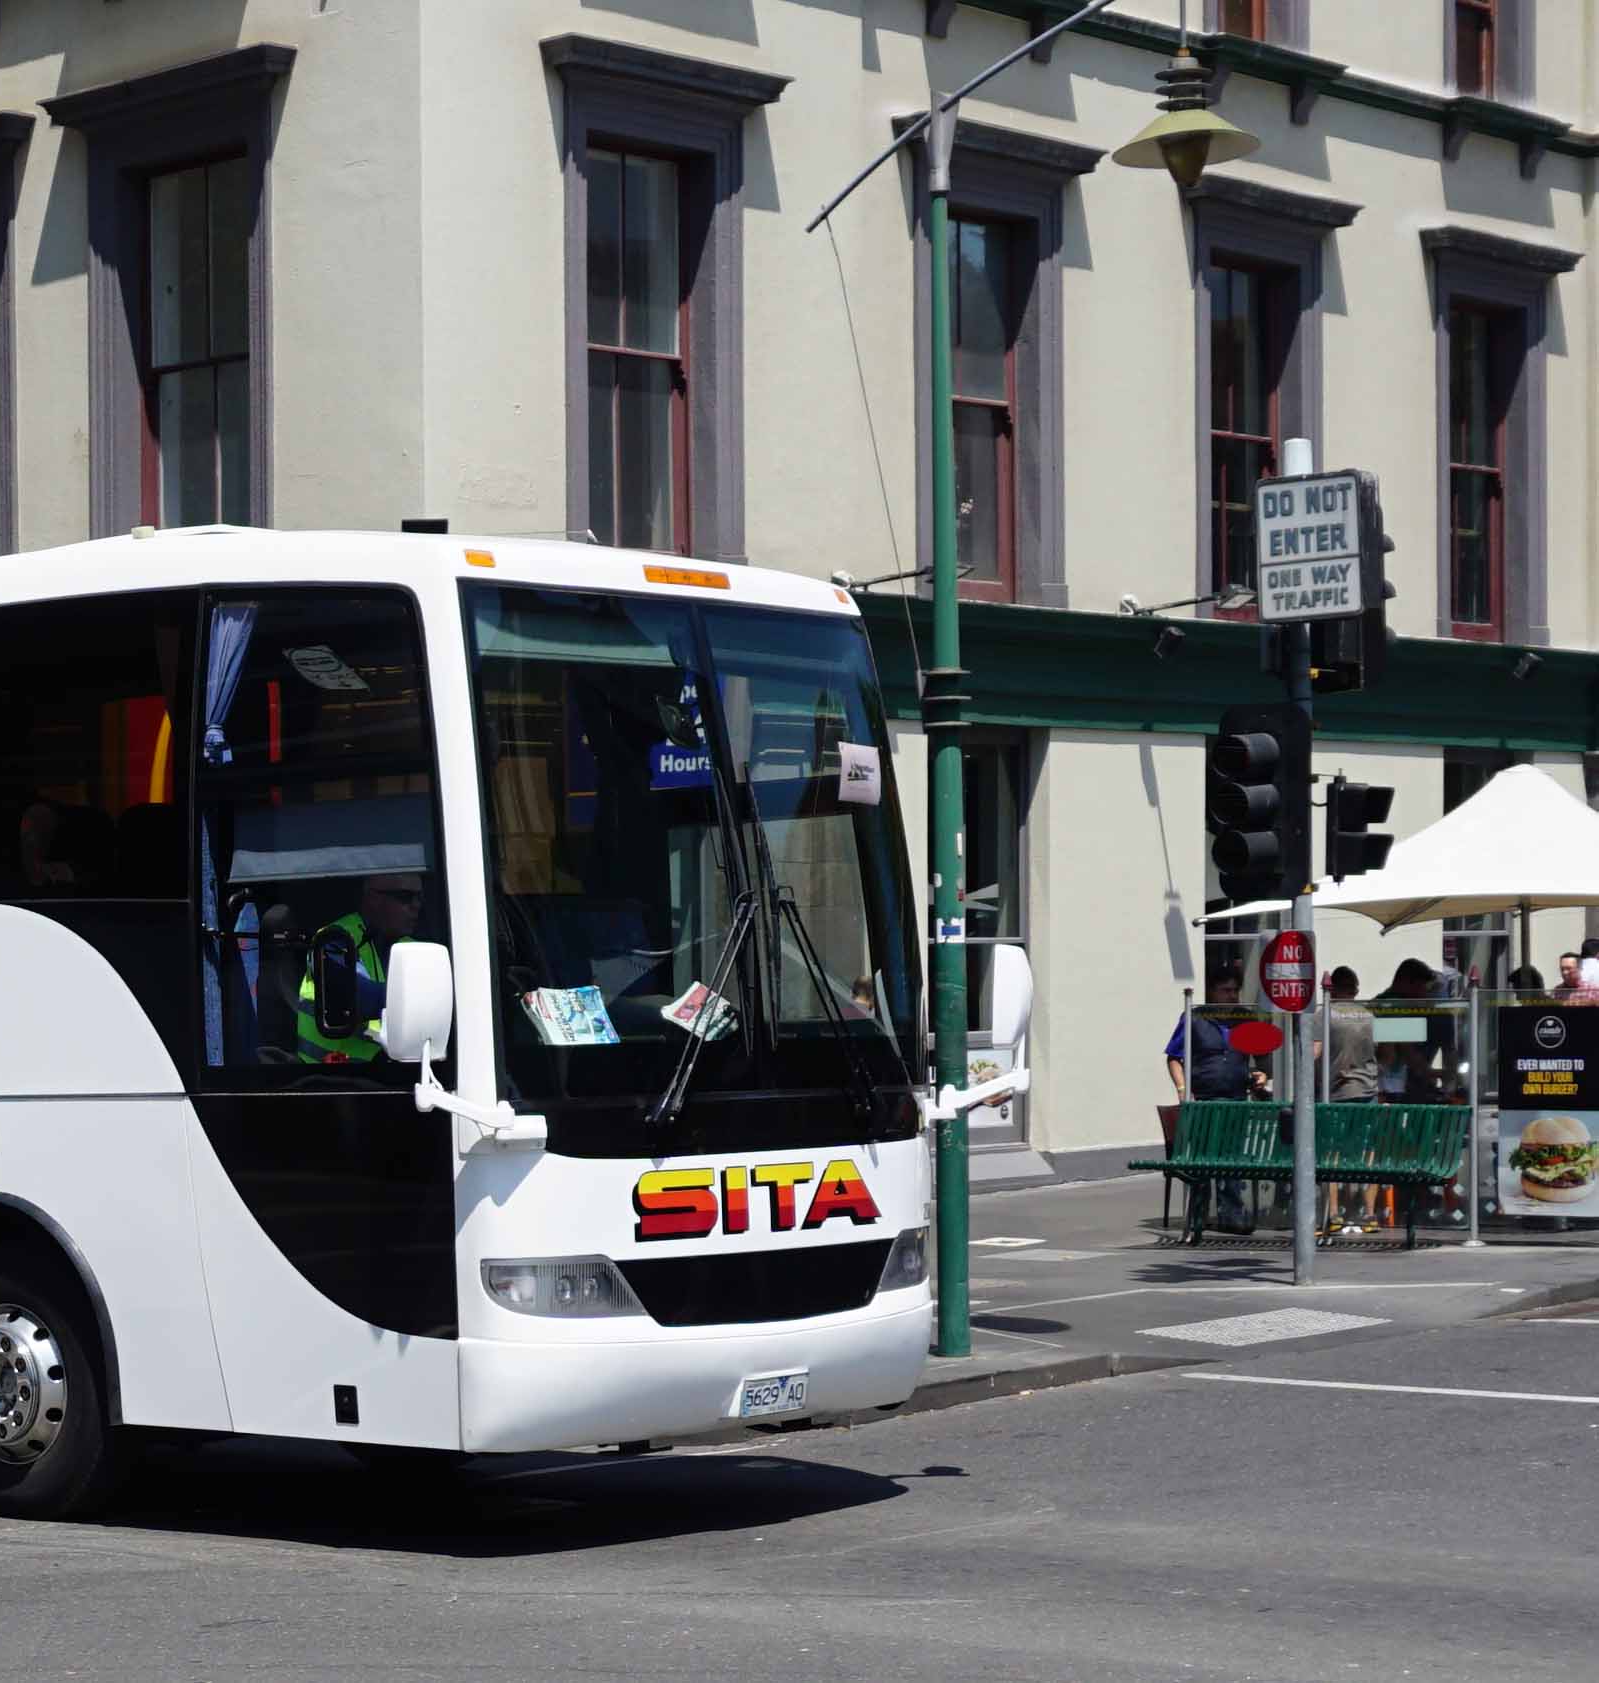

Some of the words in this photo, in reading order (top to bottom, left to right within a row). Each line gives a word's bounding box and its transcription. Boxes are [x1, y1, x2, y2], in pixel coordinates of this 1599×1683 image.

[1263, 490, 1294, 519] DO
[1305, 483, 1352, 515] NOT
[1270, 523, 1347, 557] ENTER
[1267, 568, 1302, 589] ONE
[1311, 563, 1351, 585] WAY
[1272, 587, 1349, 612] TRAFFIC
[1283, 944, 1306, 961] NO
[1517, 1059, 1538, 1070] EVER
[1539, 1059, 1572, 1070] WANTED
[1574, 1059, 1585, 1070] TO
[1528, 1072, 1551, 1082] BUILD
[632, 1159, 882, 1242] SITA
[745, 1386, 779, 1407] 5629
